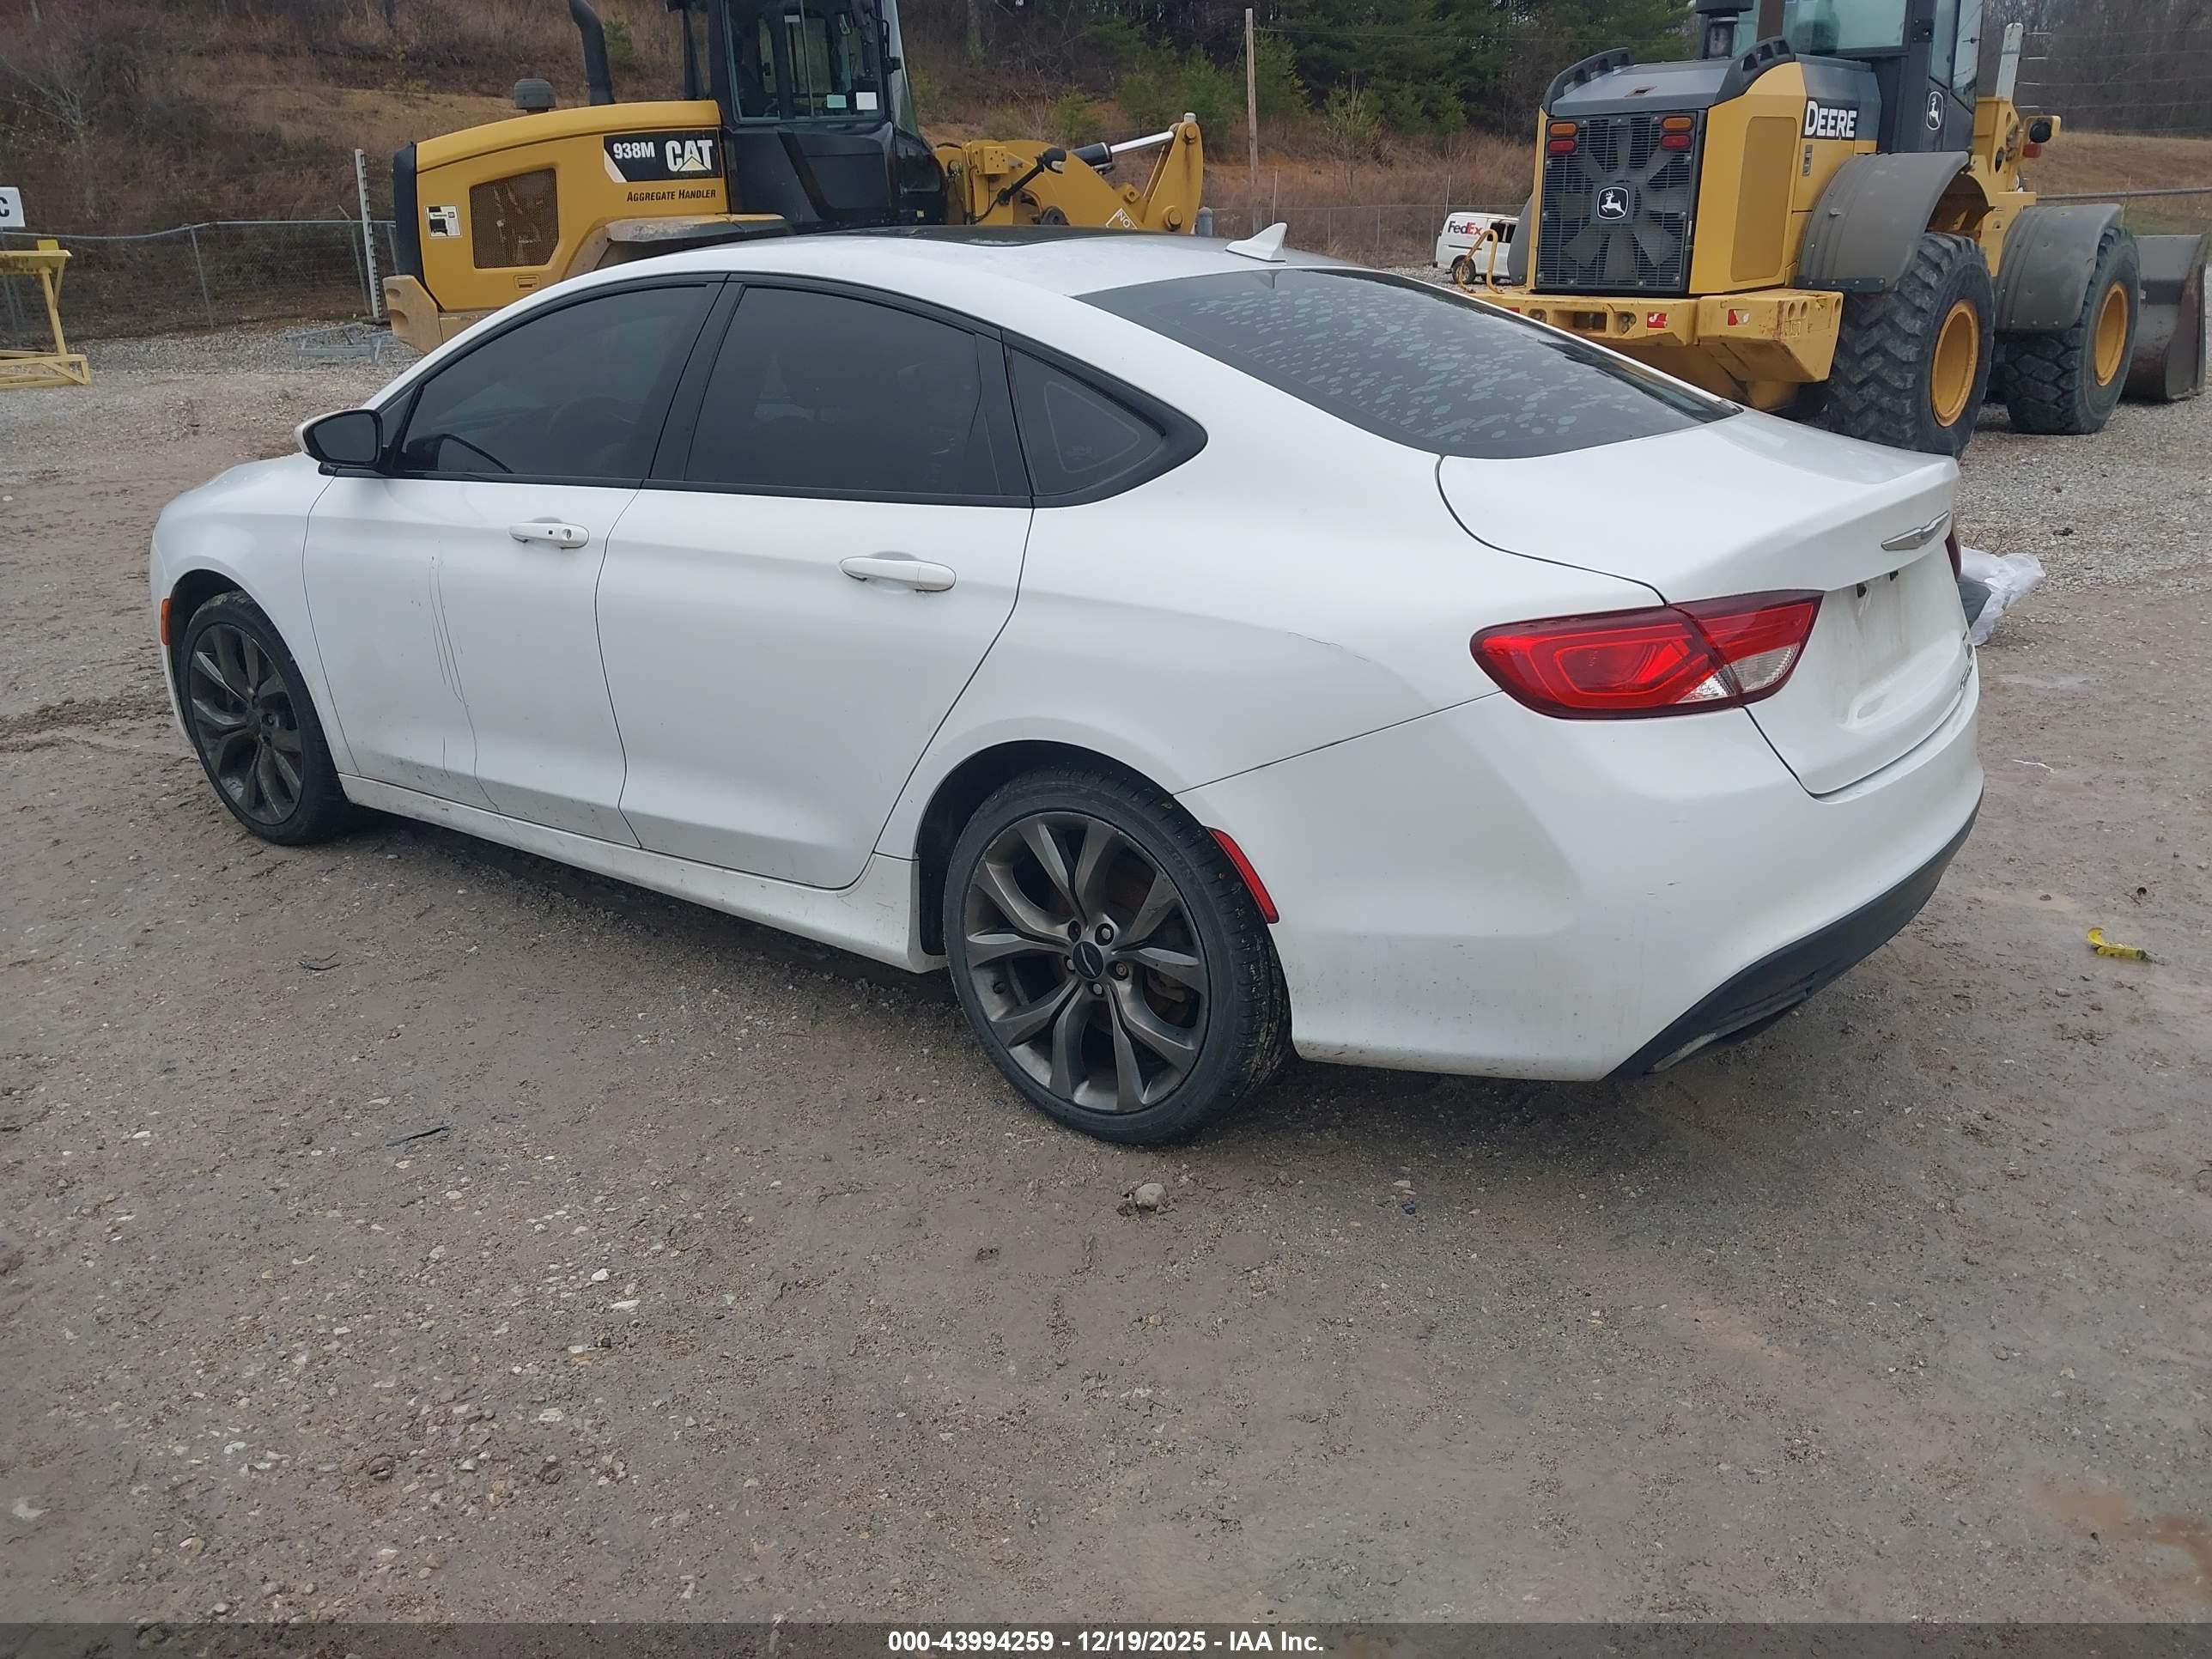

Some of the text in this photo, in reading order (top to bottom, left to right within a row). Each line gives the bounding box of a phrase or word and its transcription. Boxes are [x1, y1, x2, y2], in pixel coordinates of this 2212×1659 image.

[1804, 100, 1857, 137] DEERE
[612, 139, 713, 172] 938M CAT
[627, 189, 716, 202] AGGREGATE HANDLER
[1447, 220, 1483, 235] FedEx
